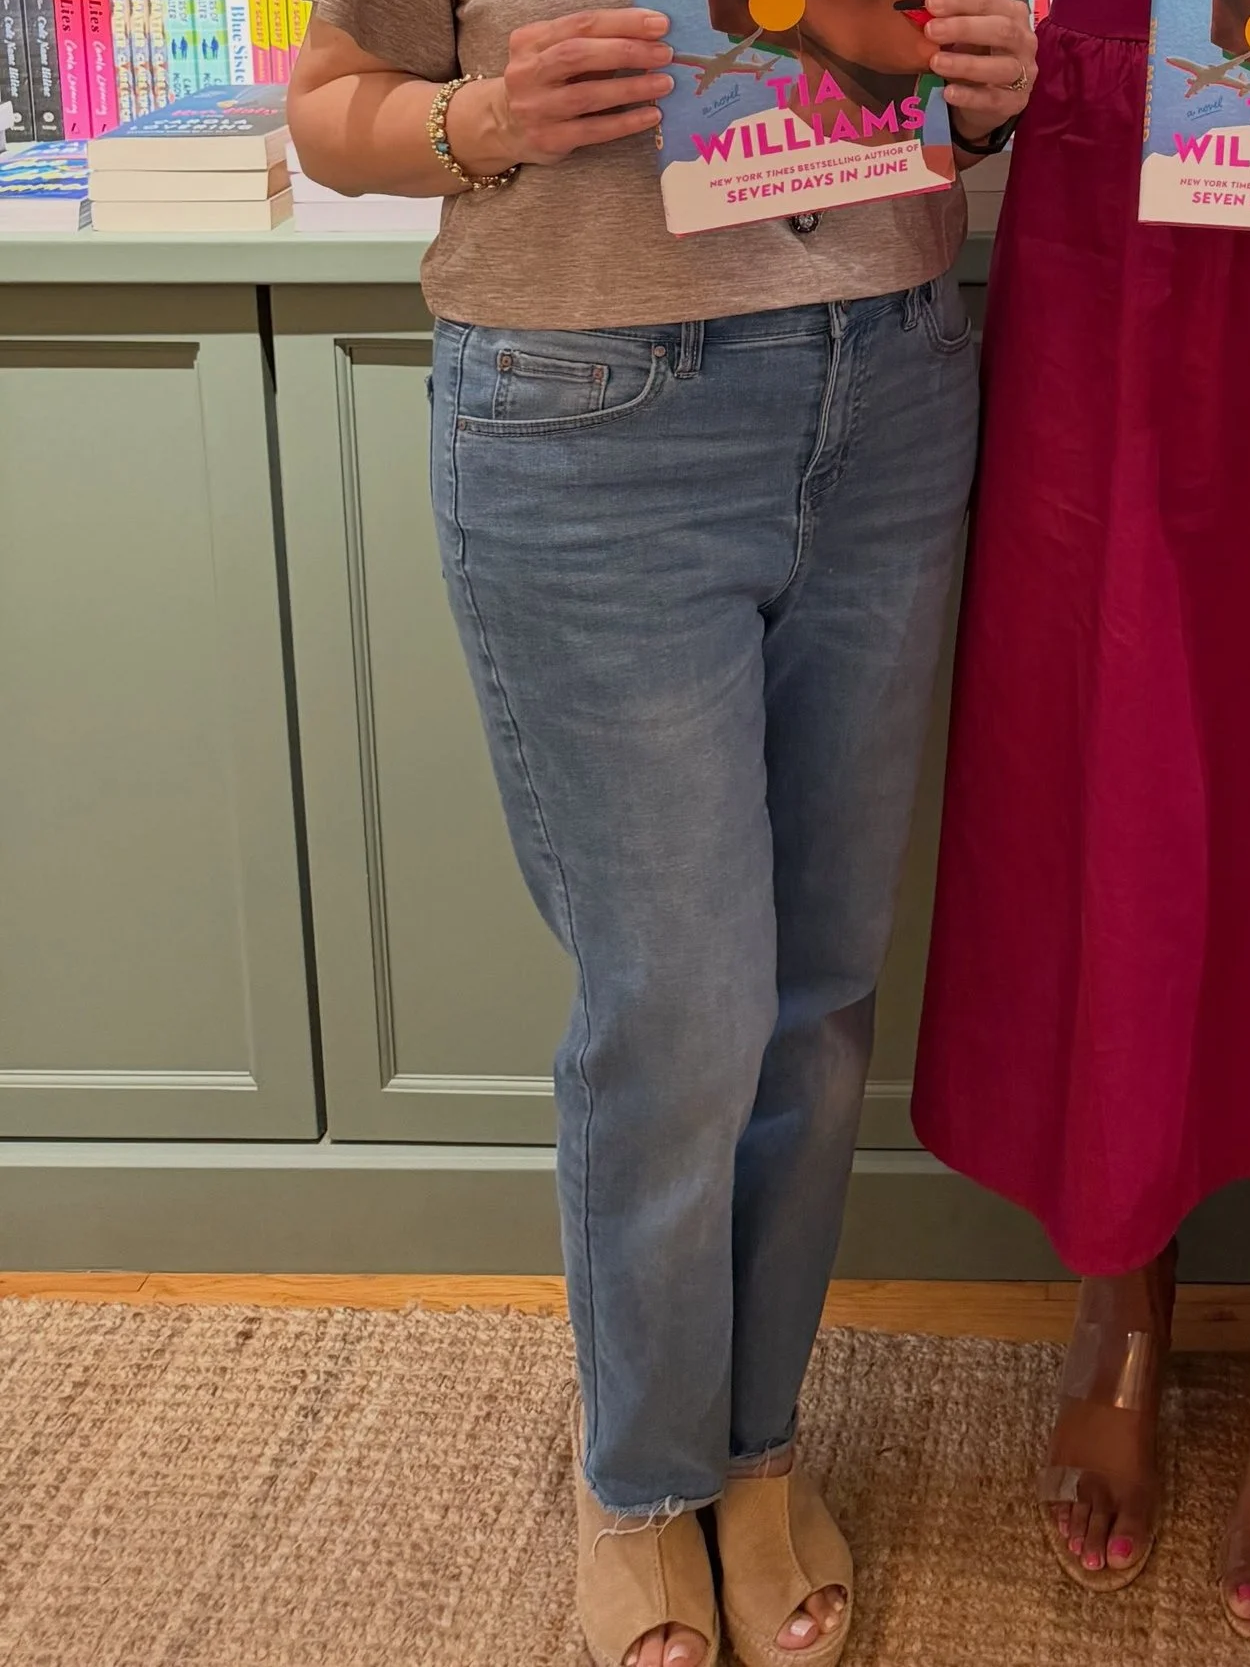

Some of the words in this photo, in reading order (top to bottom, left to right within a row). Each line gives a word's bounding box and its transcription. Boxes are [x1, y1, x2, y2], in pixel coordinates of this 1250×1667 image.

[765, 69, 846, 110] TIA
[690, 97, 926, 165] WILLIAMS
[797, 153, 862, 172] BESTSELLING
[864, 146, 905, 163] AUTHOR
[726, 183, 785, 203] SEVEN
[864, 159, 908, 179] JUNE
